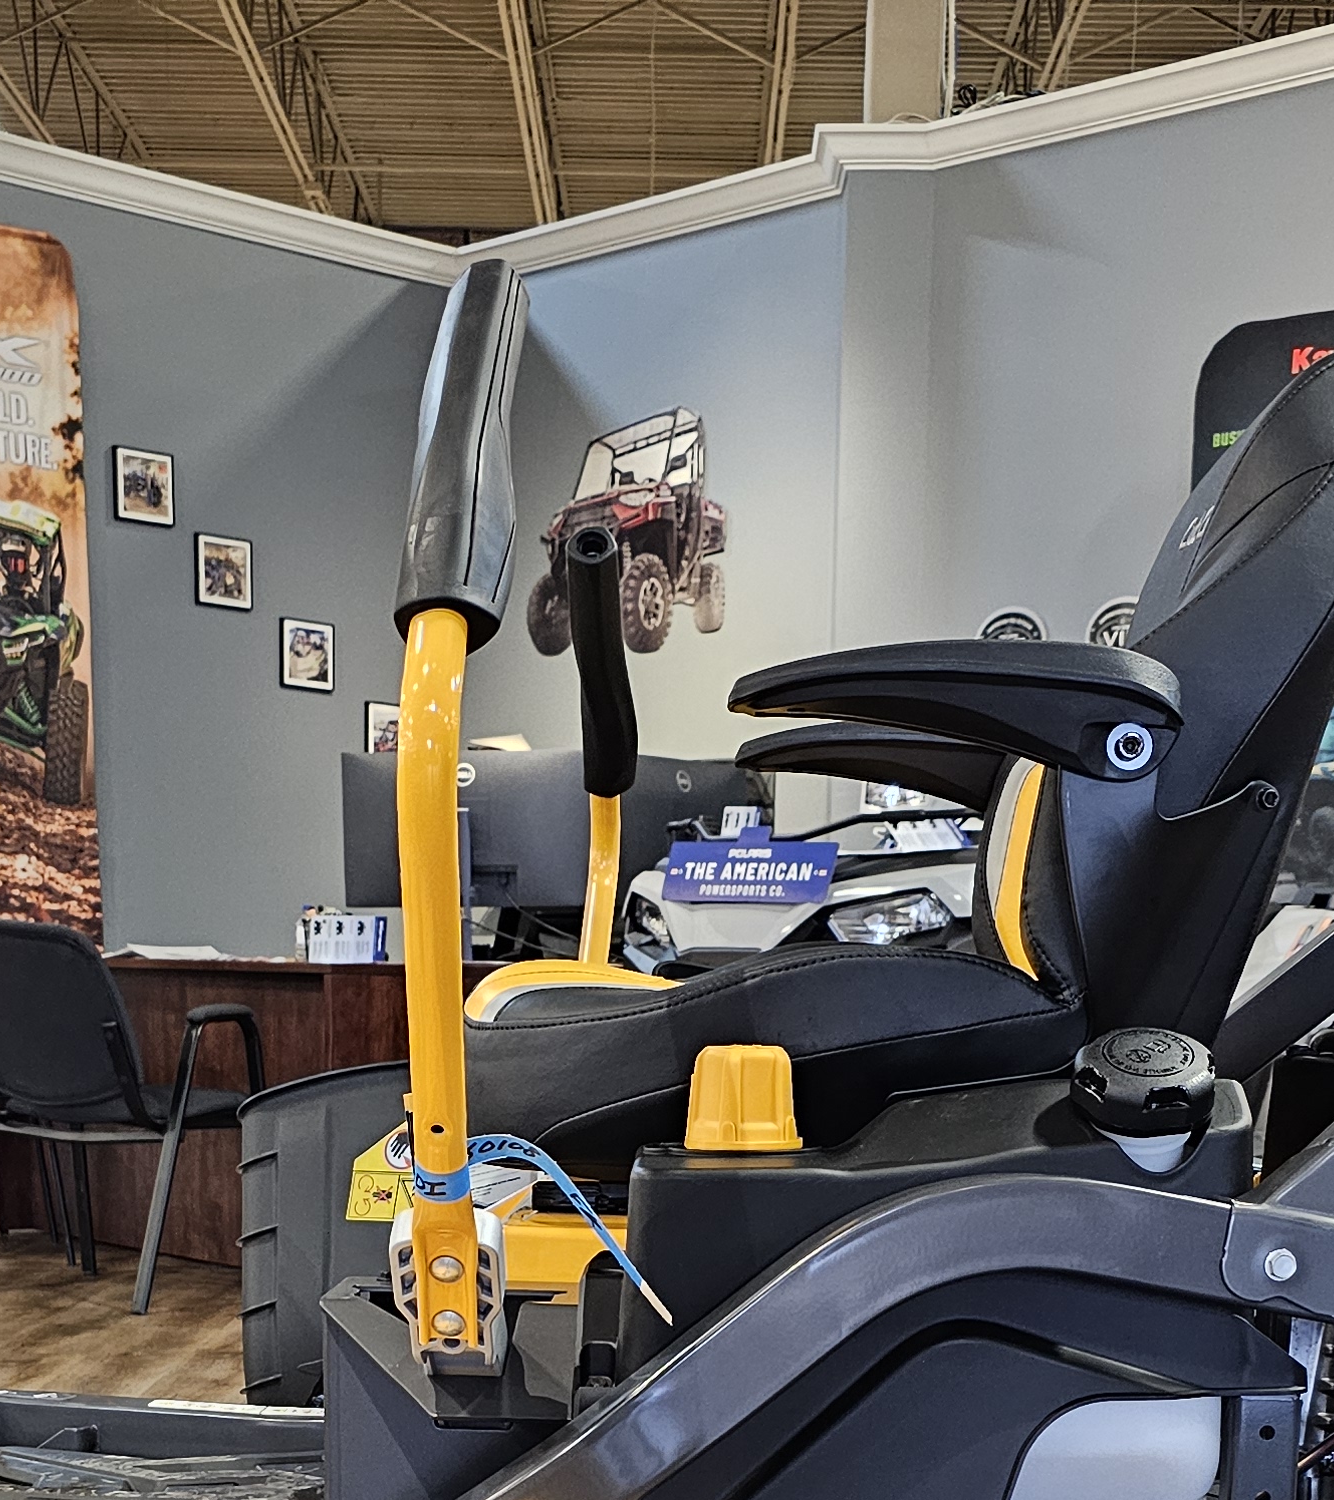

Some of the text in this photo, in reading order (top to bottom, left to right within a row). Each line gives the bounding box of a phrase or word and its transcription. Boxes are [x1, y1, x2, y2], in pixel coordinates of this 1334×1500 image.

[728, 848, 773, 859] POLARIS
[685, 861, 814, 882] THE AMERICAN
[699, 884, 786, 897] POWERSPORTS CO.
